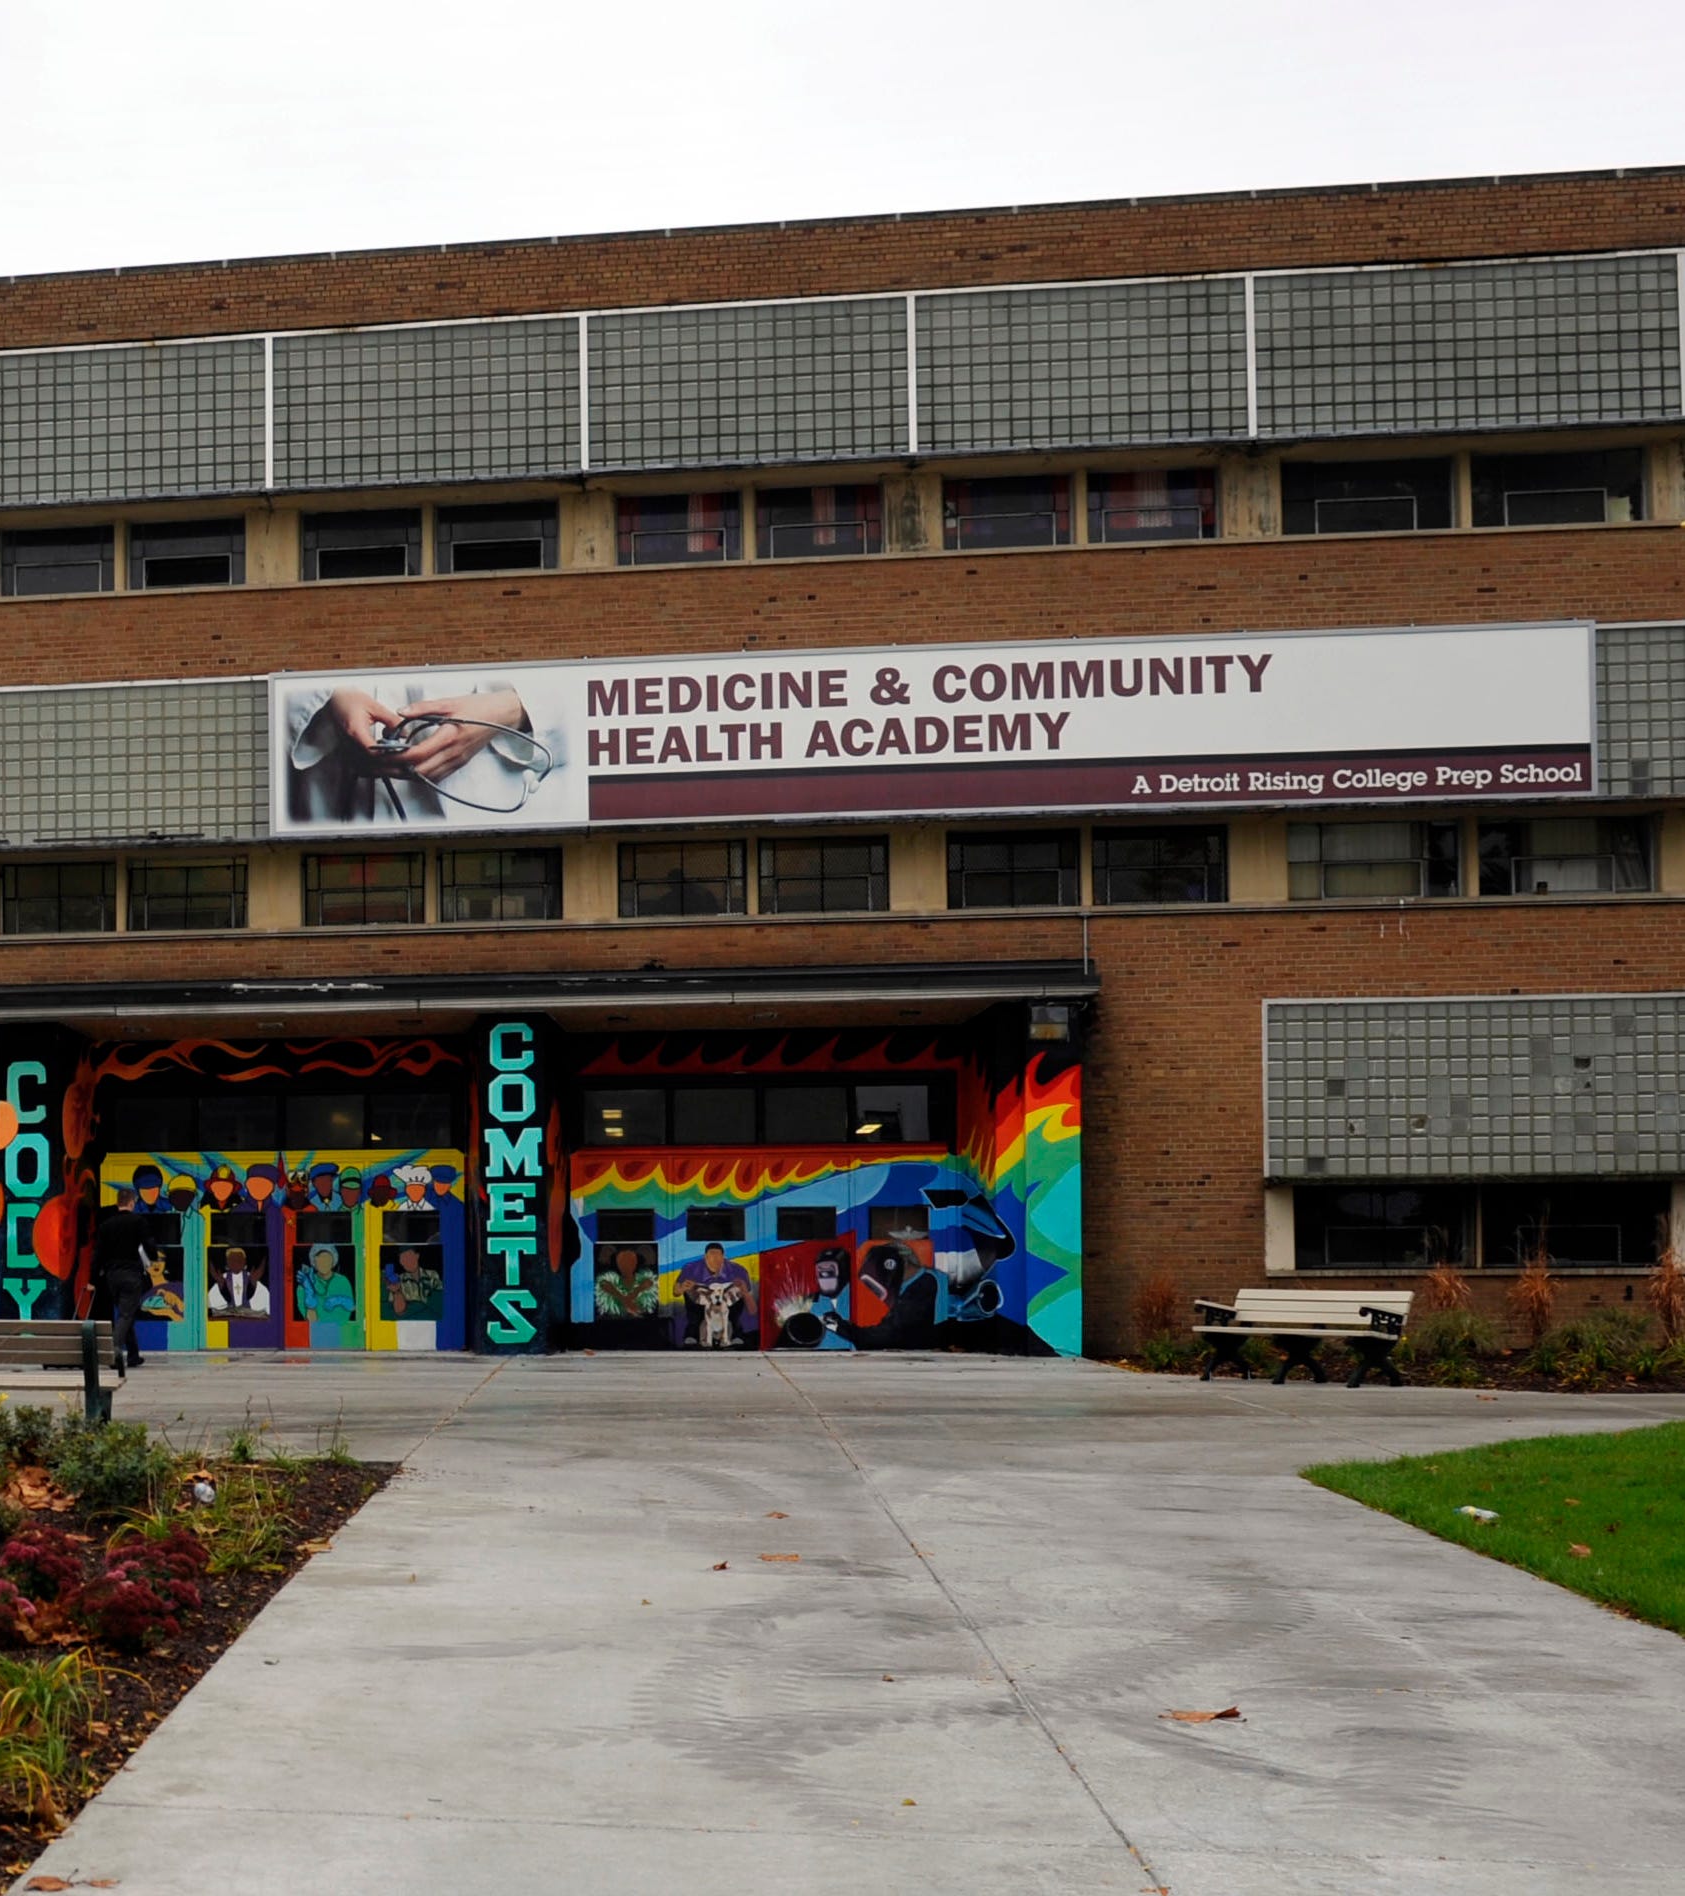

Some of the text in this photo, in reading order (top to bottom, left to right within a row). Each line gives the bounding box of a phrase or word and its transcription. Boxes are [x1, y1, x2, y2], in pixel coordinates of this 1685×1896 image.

[587, 653, 1274, 717] MEDICINE & COMMUNITY
[587, 711, 1071, 766] HEALTH ACADEMY
[1131, 762, 1583, 795] A Detroit Rising College Prep School
[2, 1060, 51, 1337] CODY
[483, 1022, 544, 1344] COMETS
